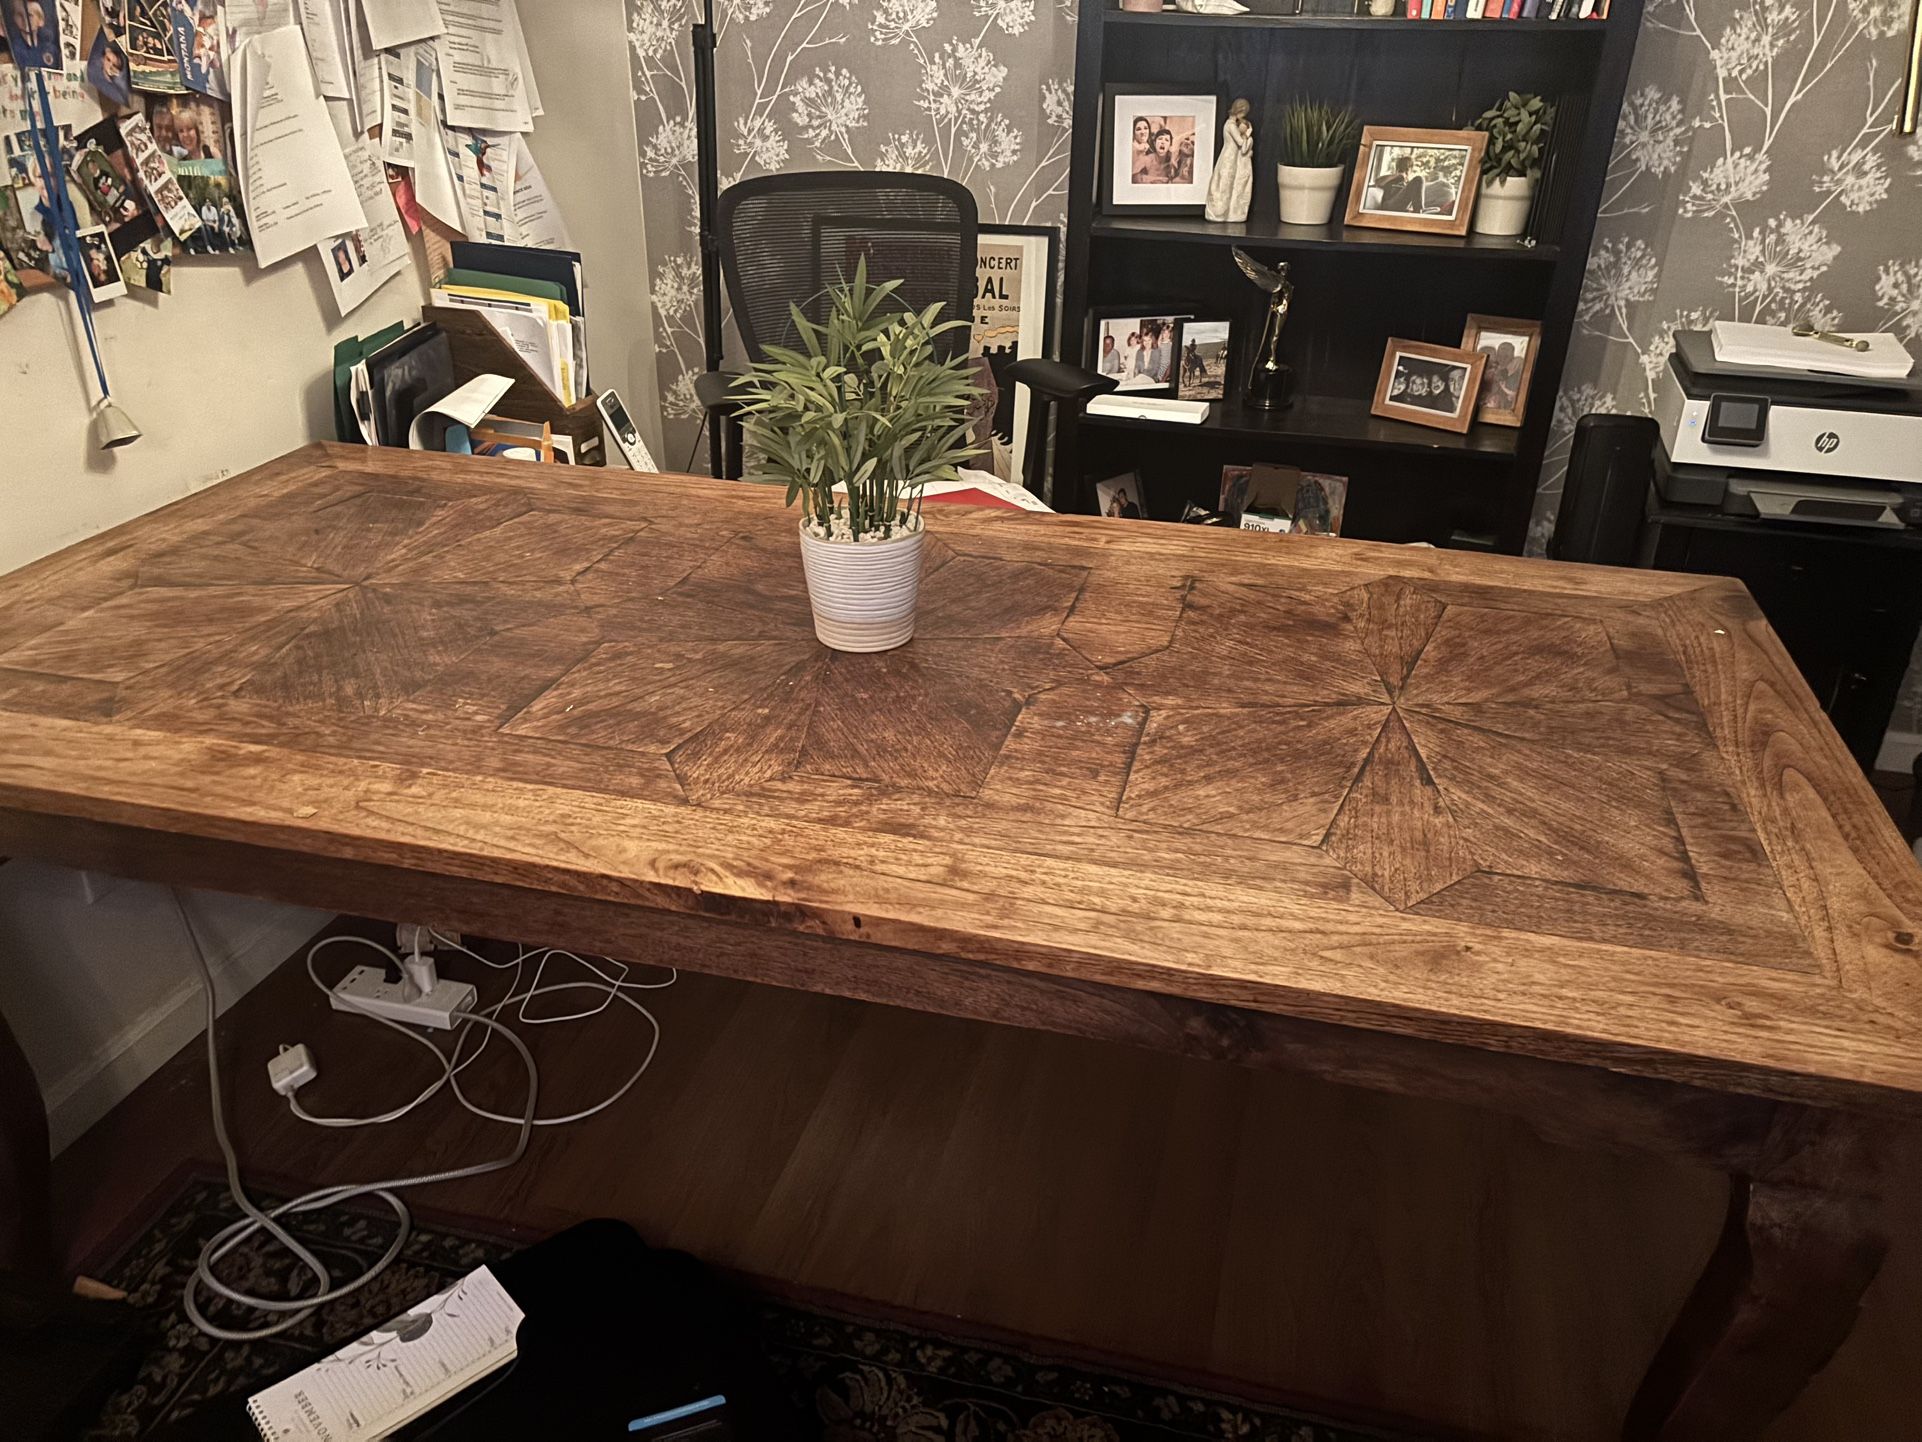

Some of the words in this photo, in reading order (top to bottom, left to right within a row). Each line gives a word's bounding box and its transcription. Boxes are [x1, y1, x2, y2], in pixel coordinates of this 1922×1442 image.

[177, 26, 194, 81] MONTANA
[976, 256, 1020, 271] NCERT
[1815, 431, 1840, 454] hp
